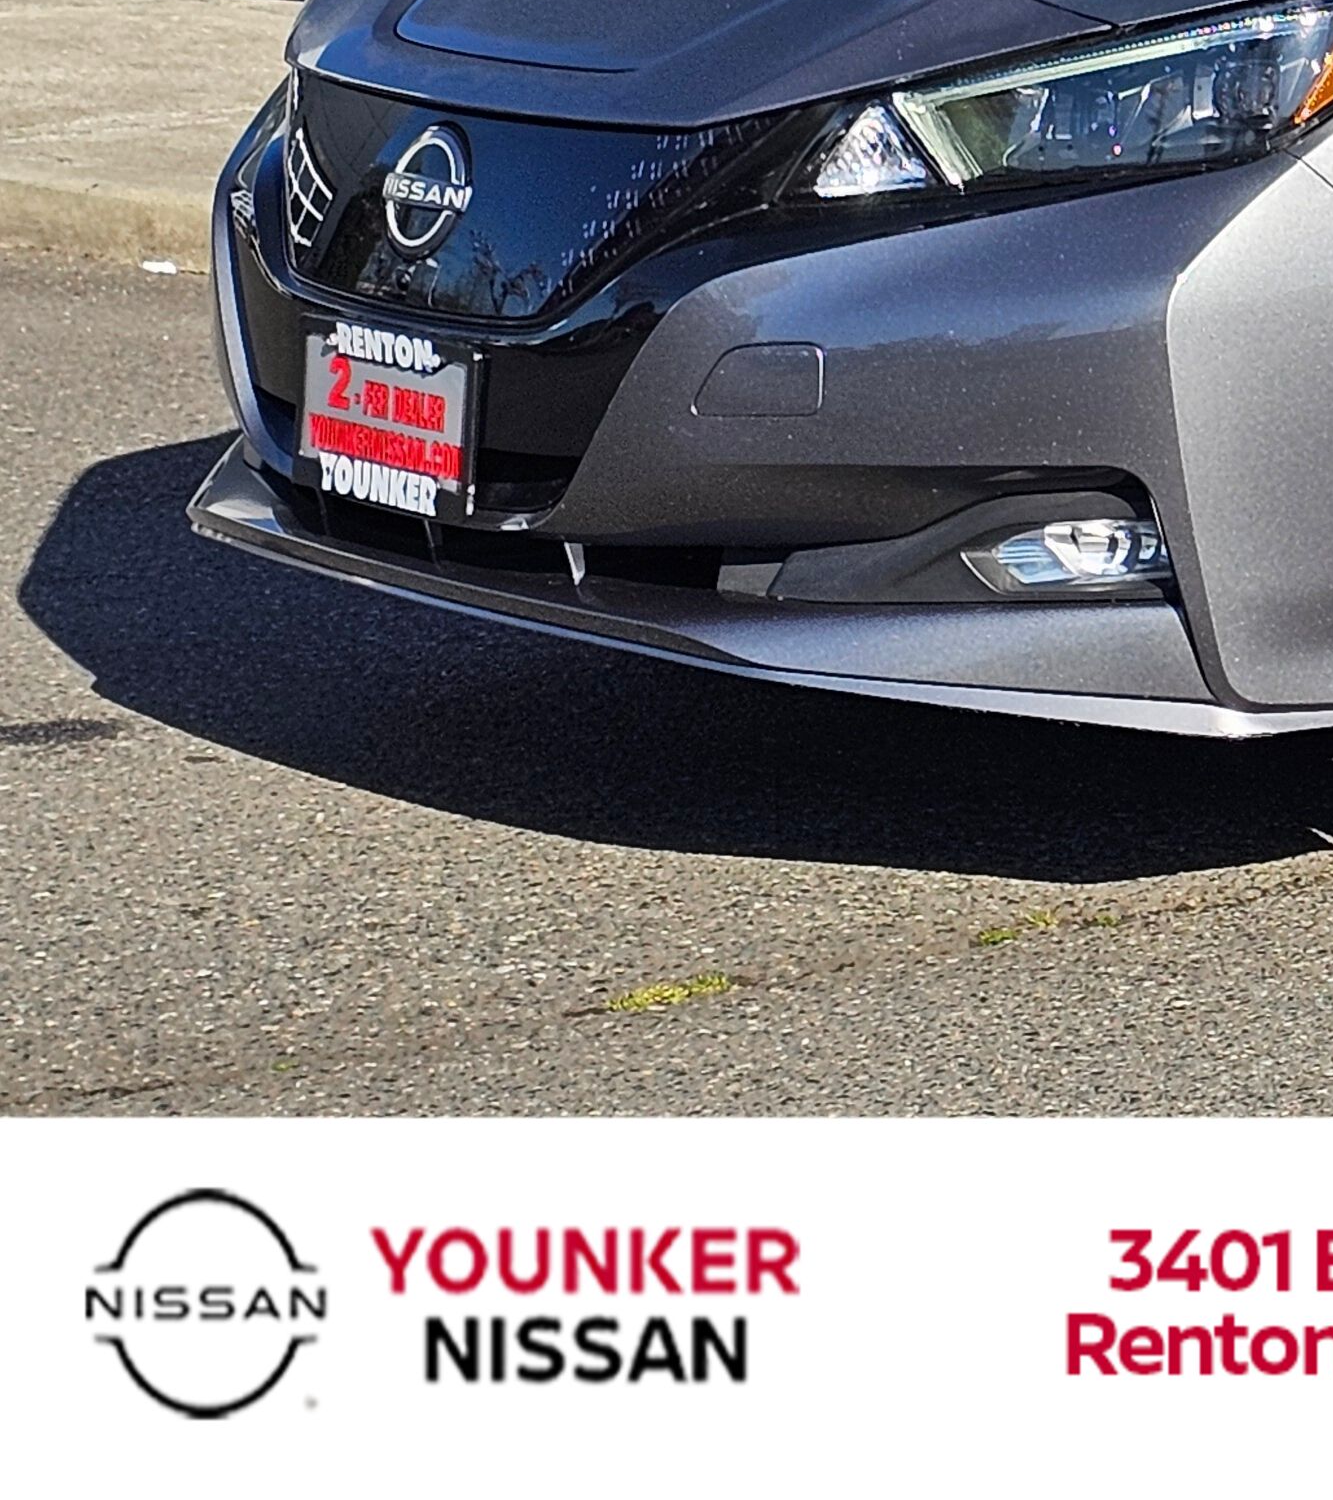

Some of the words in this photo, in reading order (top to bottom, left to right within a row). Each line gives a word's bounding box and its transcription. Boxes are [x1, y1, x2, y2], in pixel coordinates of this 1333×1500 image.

[384, 176, 465, 211] NISSAN
[335, 321, 434, 372] RENTON
[327, 354, 352, 411] 2
[319, 451, 438, 517] YOUNKER
